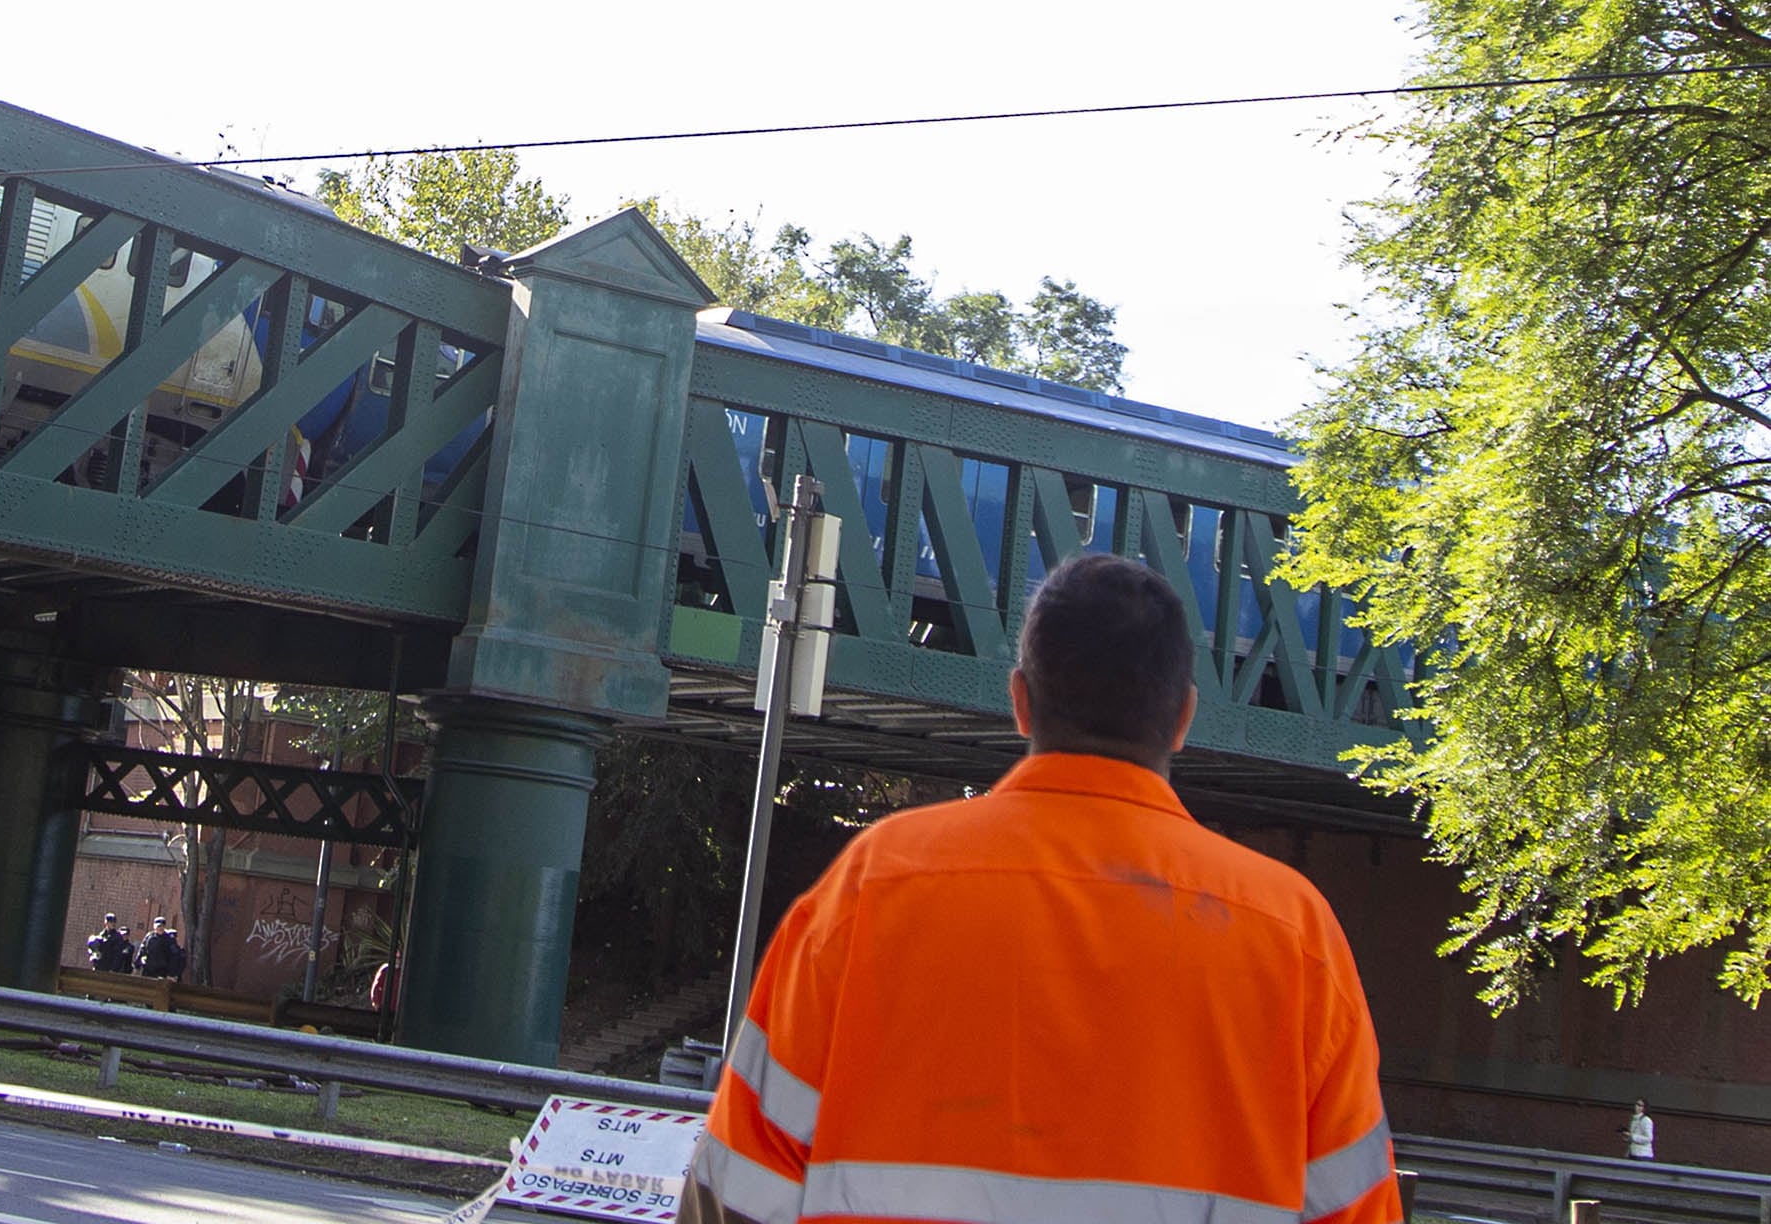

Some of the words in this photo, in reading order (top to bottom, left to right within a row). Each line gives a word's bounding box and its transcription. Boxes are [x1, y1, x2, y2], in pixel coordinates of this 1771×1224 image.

[597, 1117, 642, 1135] MTS
[580, 1148, 625, 1167] MTS
[521, 1172, 642, 1204] SOBREPASO
[645, 1192, 676, 1208] DE
